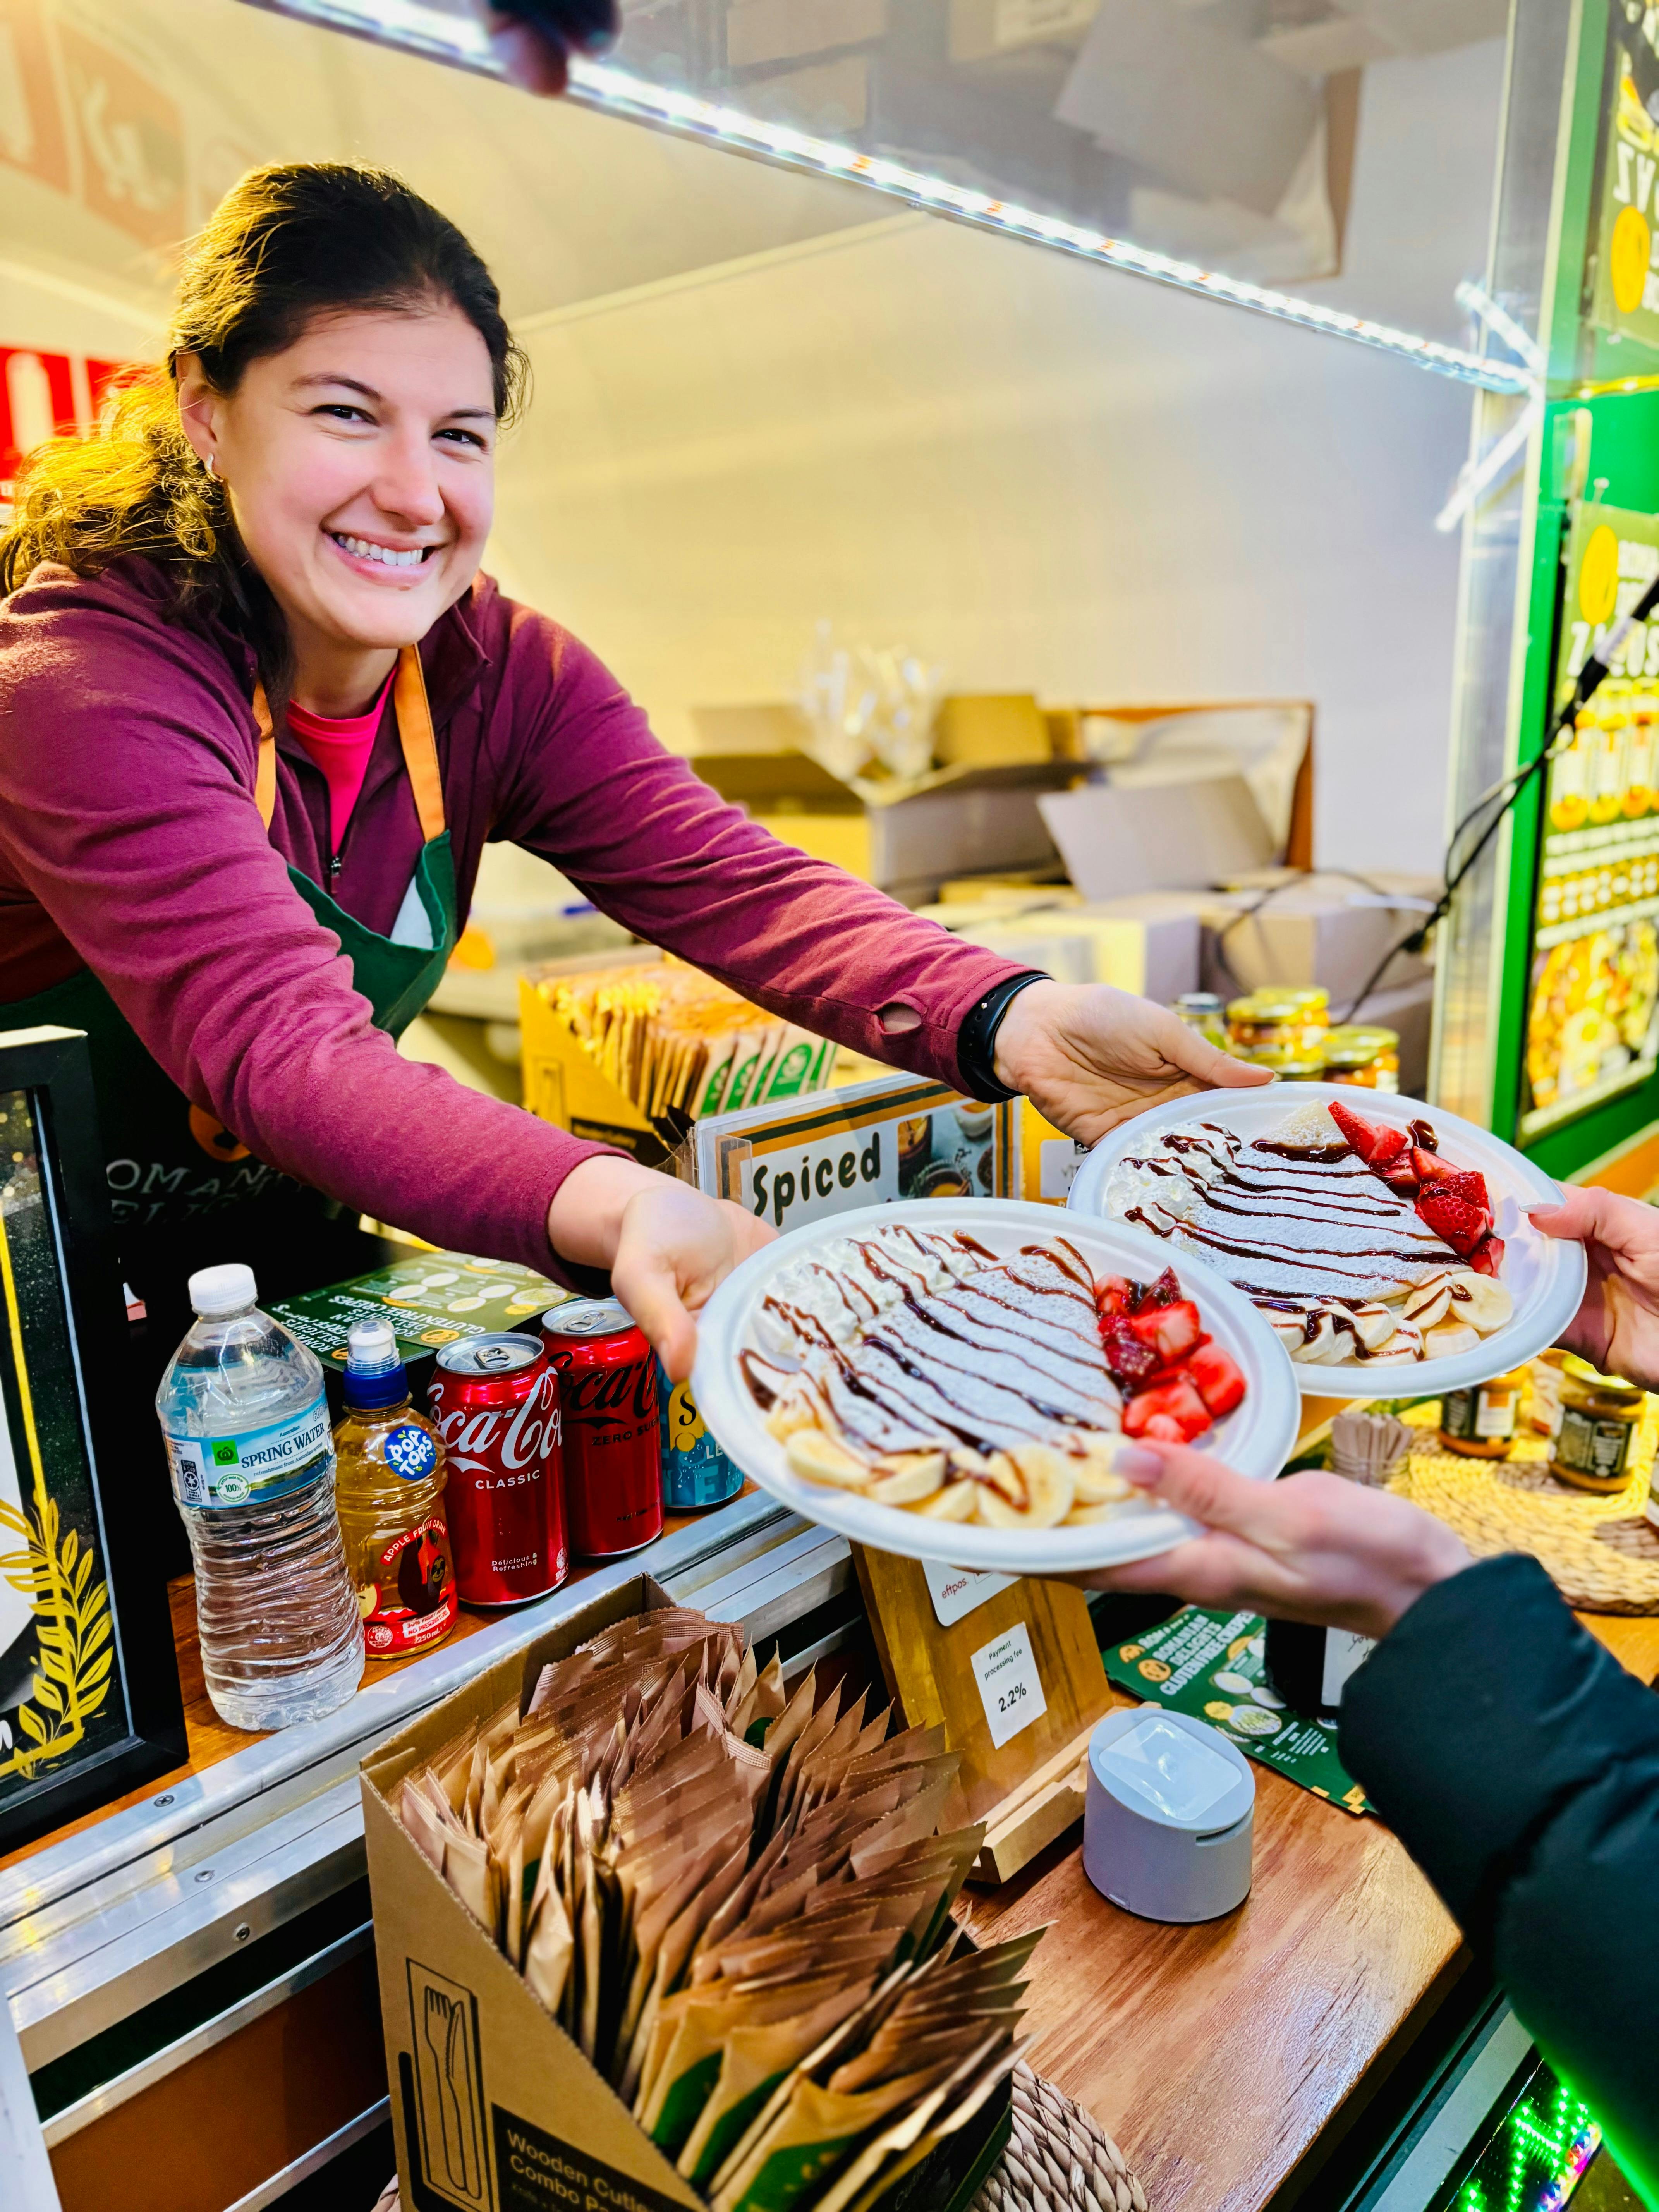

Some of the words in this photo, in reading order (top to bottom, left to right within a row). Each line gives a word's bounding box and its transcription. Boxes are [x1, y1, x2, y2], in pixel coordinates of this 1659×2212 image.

[753, 1131, 881, 1227] Spiced
[328, 1295, 388, 1313] CREPES
[386, 1305, 423, 1324] FREE
[280, 1319, 348, 1346] DELIGHTS
[420, 1312, 486, 1334] GLUTEN
[241, 1441, 292, 1468] SPRING
[293, 1422, 325, 1450] WATER
[388, 1430, 421, 1463] POP
[592, 1431, 632, 1446] ZERO
[398, 1435, 433, 1475] TOPS
[224, 1483, 242, 1493] 100%
[475, 1470, 540, 1489] CLASSIC
[383, 1534, 411, 1562] APPLE
[412, 1519, 432, 1538] FRUIT
[432, 1519, 446, 1535] DRINK
[491, 1555, 530, 1566] Delicious
[493, 1559, 537, 1571] Refreshing
[941, 1577, 967, 1599] eftpos
[989, 1640, 1012, 1661] Payment
[1152, 1614, 1210, 1662] ROMANIAN
[1168, 1621, 1223, 1666] DELIGHTS
[984, 1654, 1013, 1681] processing
[1014, 1648, 1023, 1659] fee
[1159, 1657, 1206, 1696] GLUTEN
[1194, 1638, 1227, 1665] FREE
[998, 1682, 1027, 1713] 2.2%
[507, 2129, 588, 2187] Wooden
[509, 2154, 580, 2204] Combo
